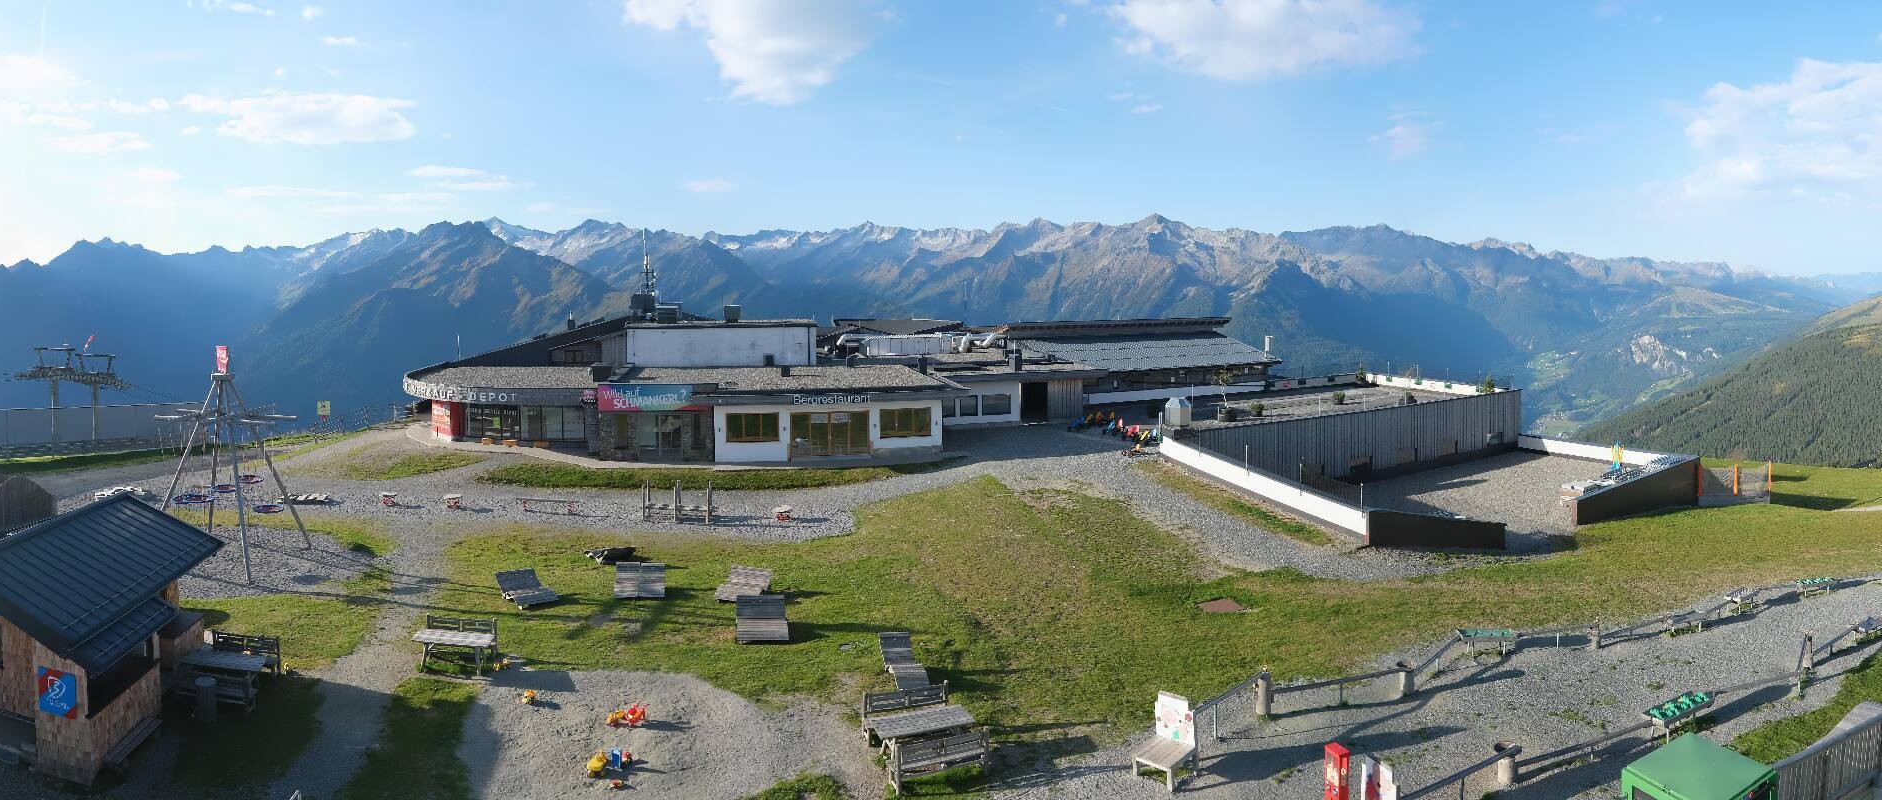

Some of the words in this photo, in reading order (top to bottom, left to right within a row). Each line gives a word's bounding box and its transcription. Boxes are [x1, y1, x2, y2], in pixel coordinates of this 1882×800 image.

[412, 386, 453, 400] VERKAUF
[468, 391, 518, 402] DEPOT
[603, 388, 624, 400] Wild
[626, 386, 641, 398] auf
[613, 389, 687, 409] SCHMANKERL?
[793, 394, 871, 406] Bergrestaurant
